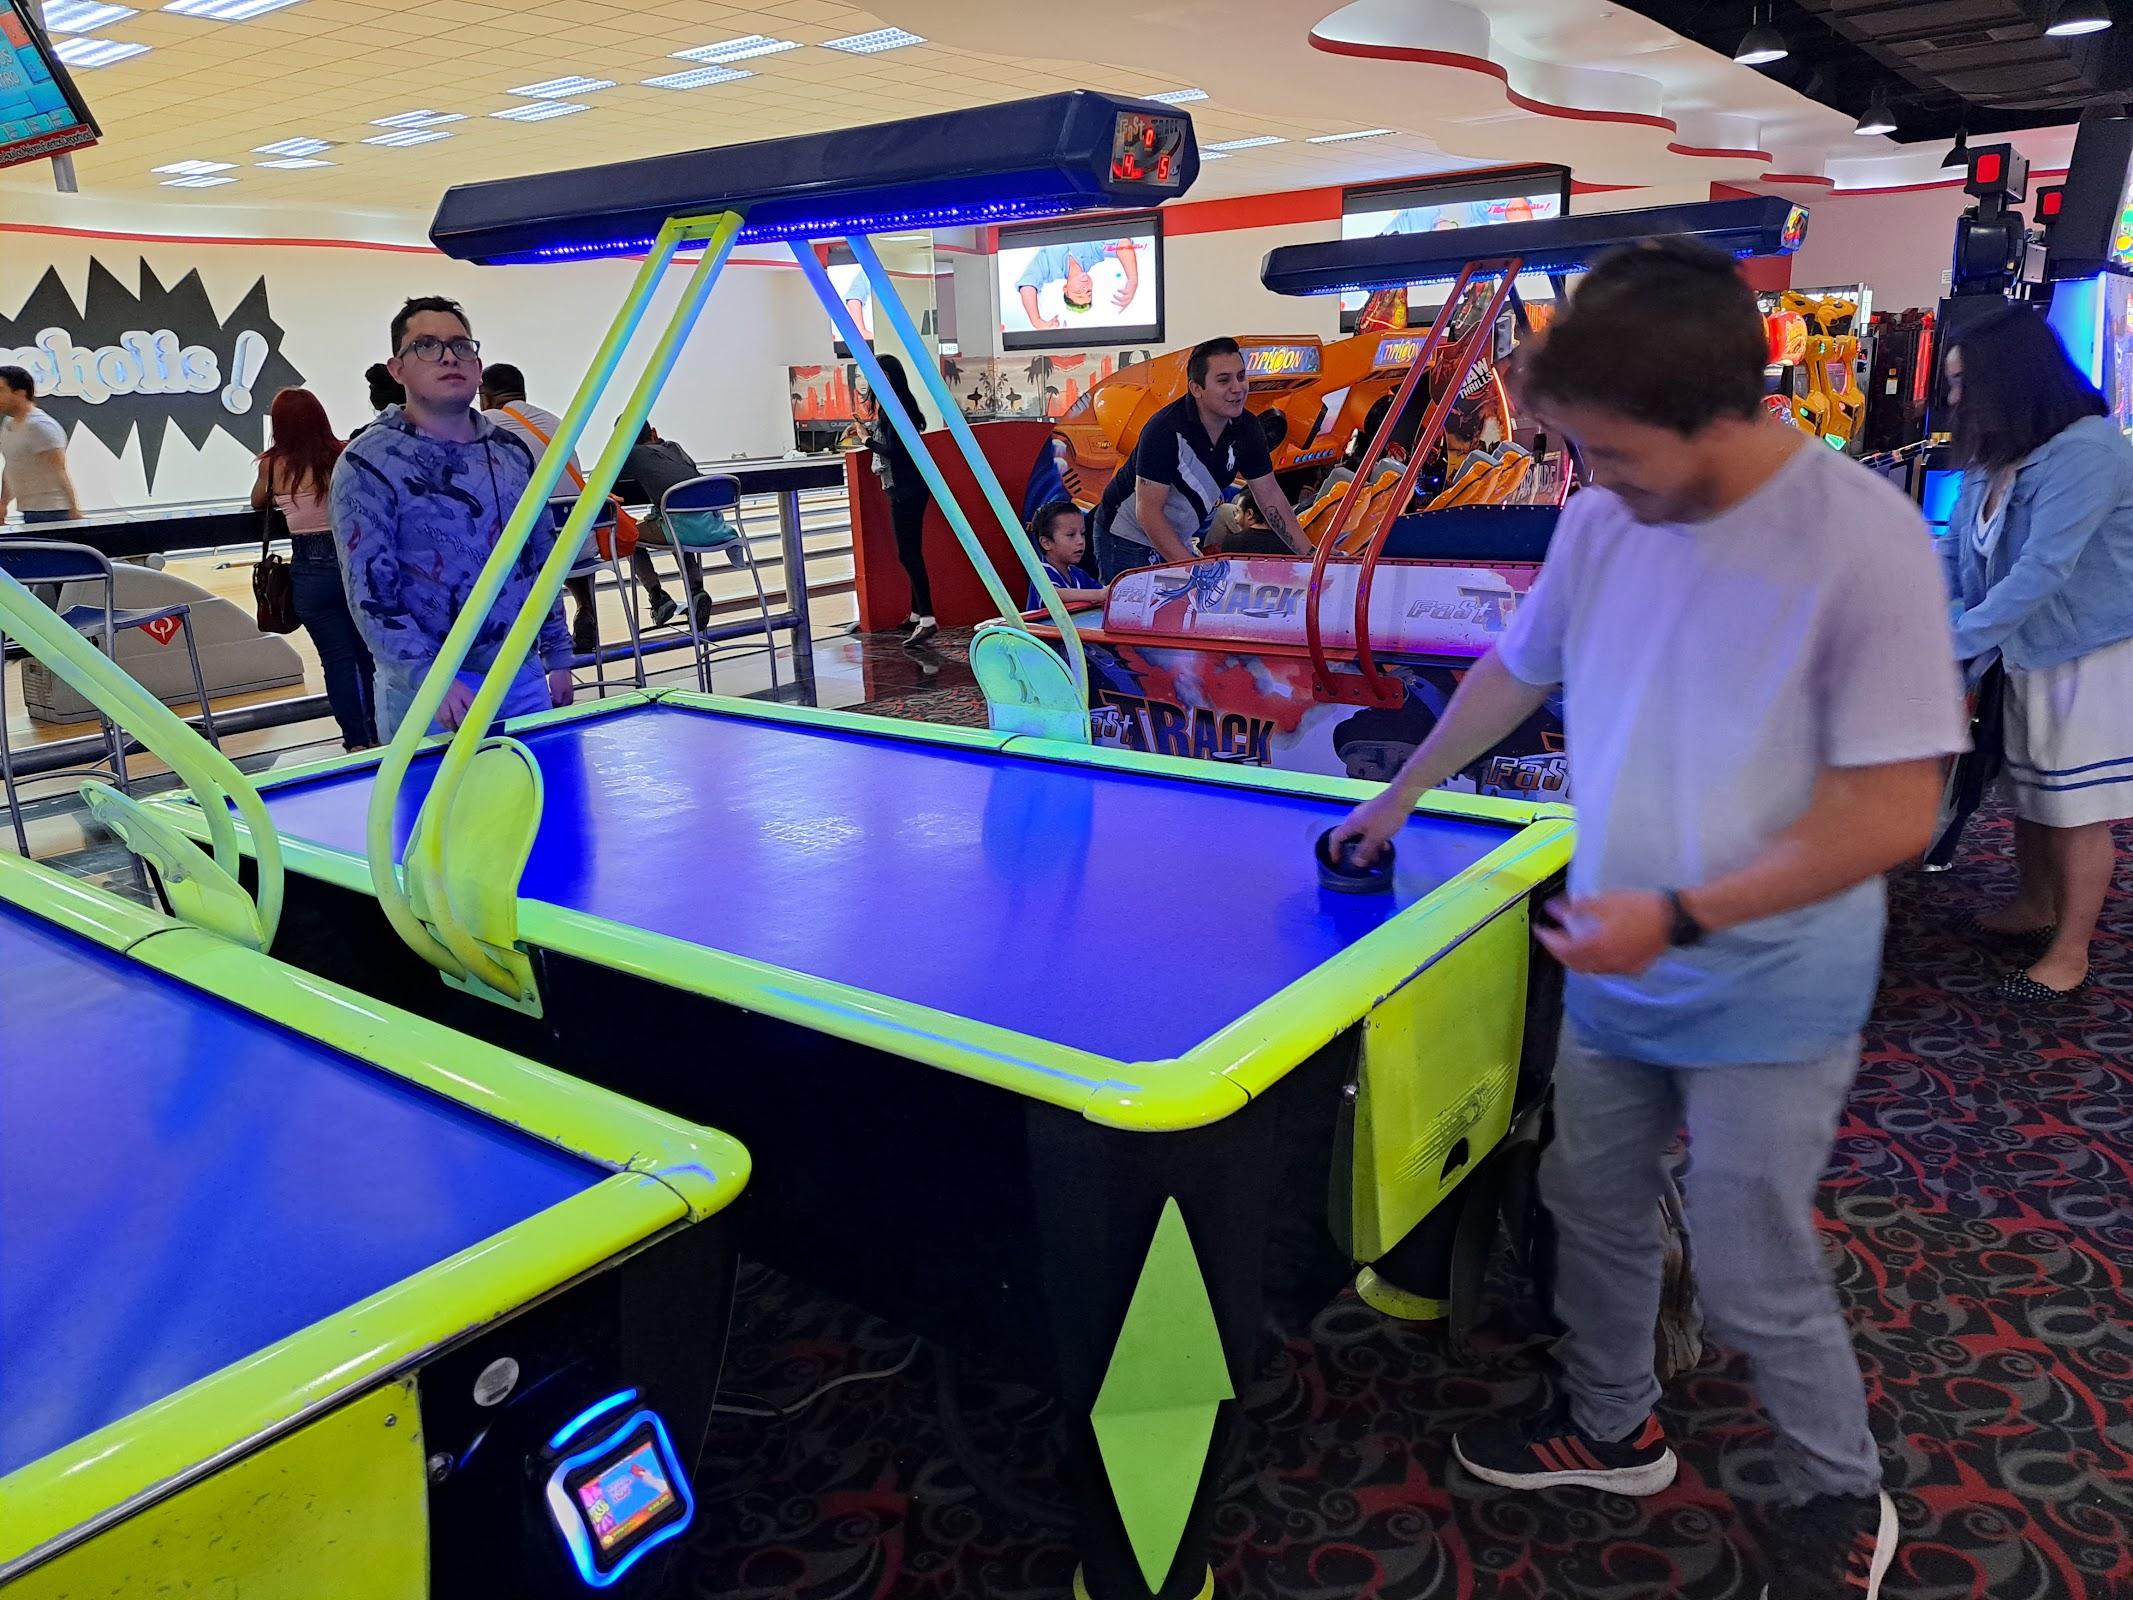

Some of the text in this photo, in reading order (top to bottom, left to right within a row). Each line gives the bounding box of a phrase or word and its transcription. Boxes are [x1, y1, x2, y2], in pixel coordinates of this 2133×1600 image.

[1145, 129, 1155, 146] 0
[1124, 154, 1134, 176] 4
[1159, 156, 1169, 178] 5
[1247, 347, 1303, 374] TYPHOON
[1462, 357, 1489, 388] AW
[1459, 371, 1494, 400] THRILLS
[1090, 689, 1276, 766] aSt TRACK
[1486, 755, 1570, 796] FaS
